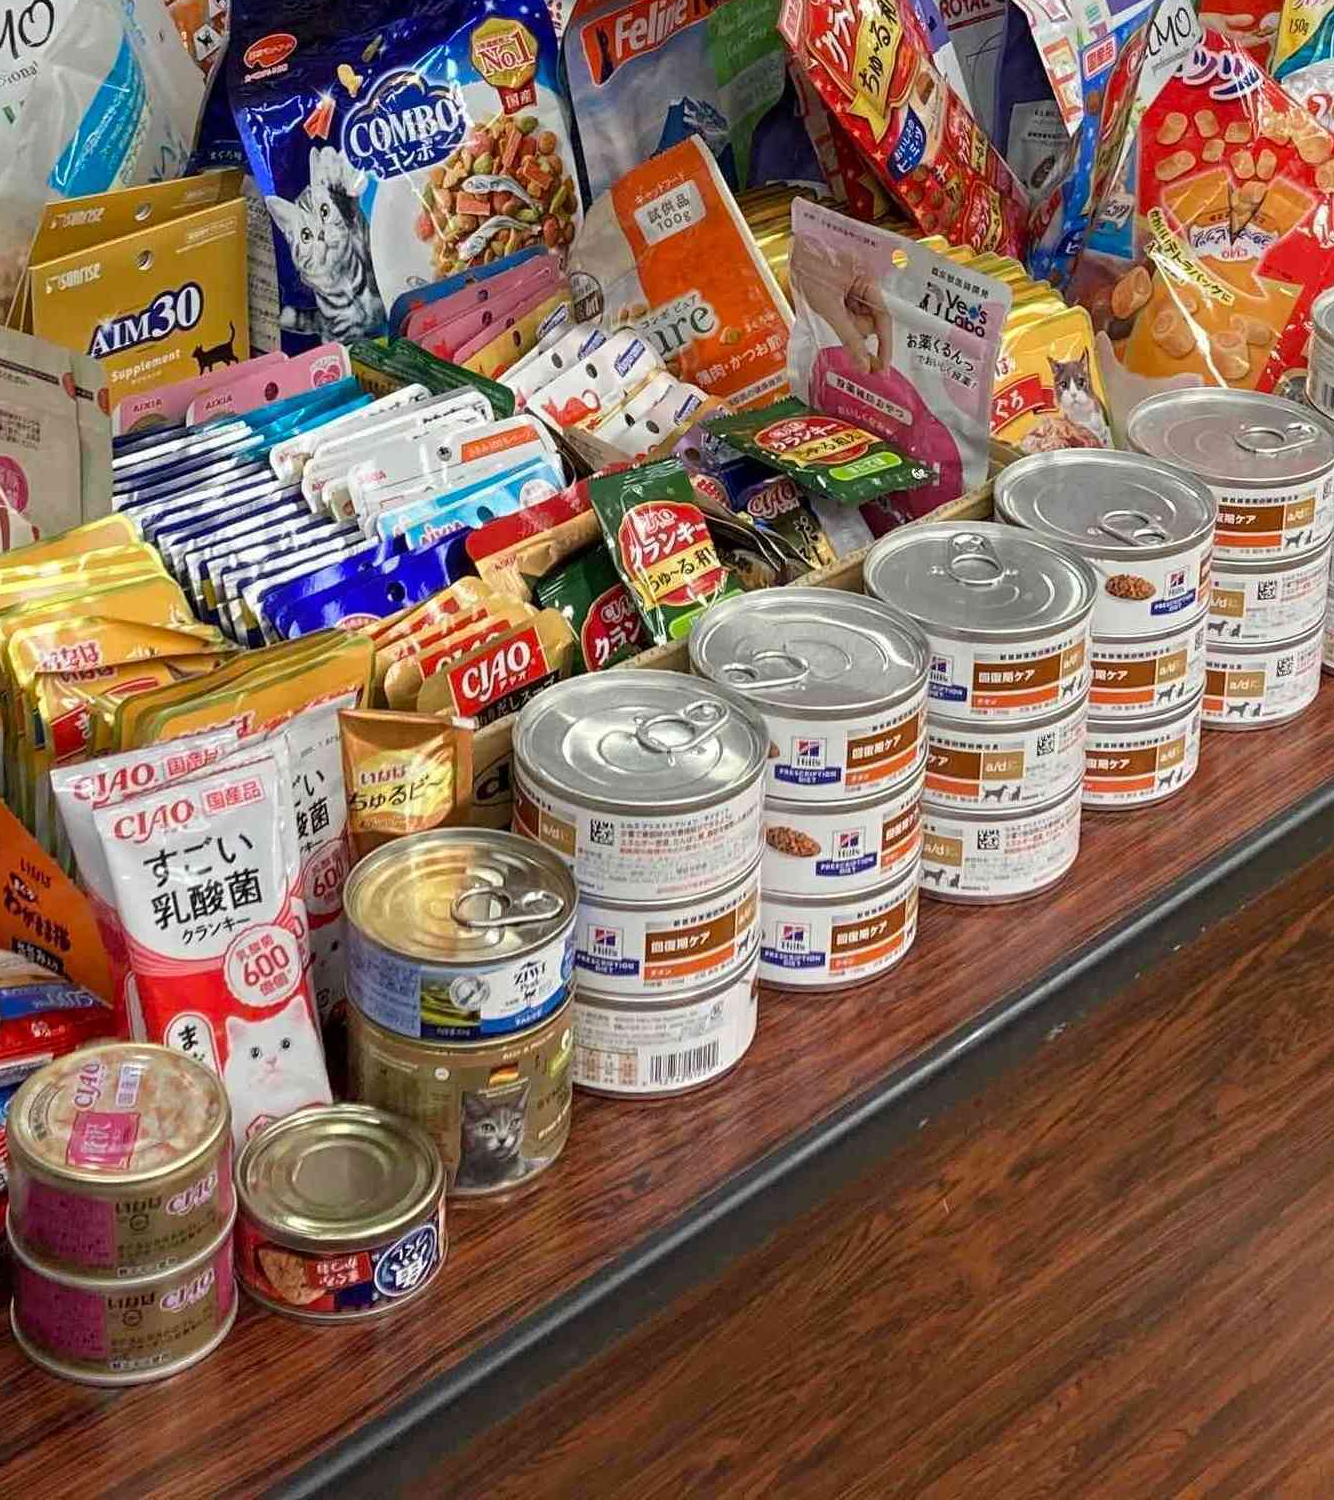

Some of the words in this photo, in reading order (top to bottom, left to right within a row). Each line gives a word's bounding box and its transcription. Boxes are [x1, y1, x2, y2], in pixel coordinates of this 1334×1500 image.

[503, 90, 535, 110] 国産
[348, 99, 457, 160] COMBO
[385, 143, 436, 178] コンボ
[647, 192, 691, 225] 試供品
[656, 209, 692, 232] 100g
[90, 282, 201, 358] AIM30
[647, 304, 715, 357] ure
[944, 307, 986, 339] Labo
[109, 346, 182, 385] Supplement
[461, 640, 531, 703] CIAO
[774, 764, 842, 783] PRESCRIPTION
[985, 756, 1009, 775] a/d
[206, 780, 264, 812] 国産品
[110, 799, 197, 845] CIAO
[143, 831, 254, 887] すごい
[151, 868, 264, 929] 乳酸菌
[181, 913, 252, 946] クランキー
[241, 946, 290, 986] 600
[73, 1061, 101, 1112] CIAO
[165, 1172, 218, 1217] CIAO
[159, 1267, 216, 1314] CIAO
